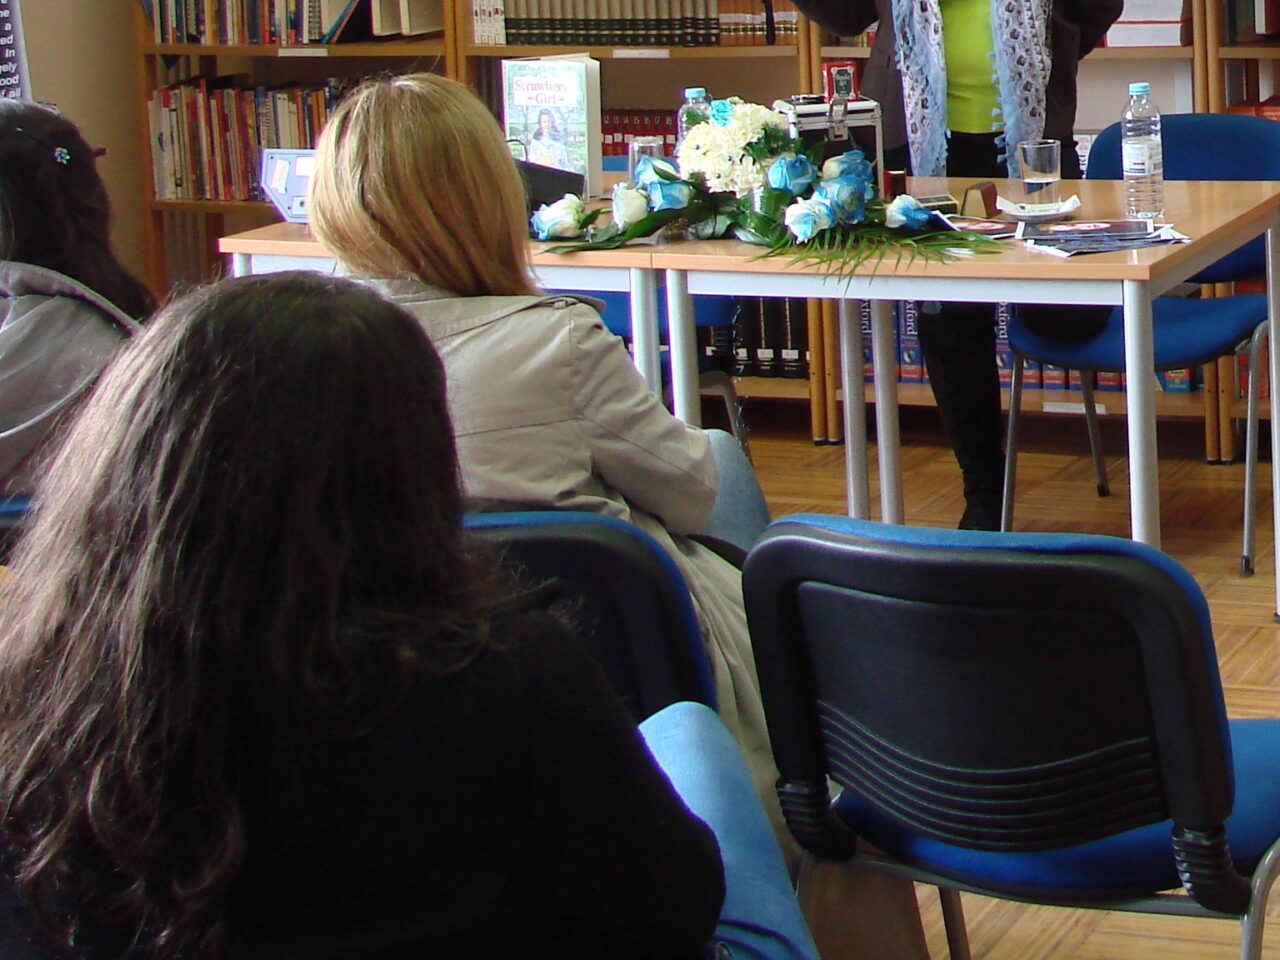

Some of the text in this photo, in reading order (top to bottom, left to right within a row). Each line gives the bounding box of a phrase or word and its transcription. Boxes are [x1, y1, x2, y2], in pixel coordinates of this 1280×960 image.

[5, 22, 12, 31] a
[860, 299, 873, 335] xford
[906, 299, 918, 336] xford
